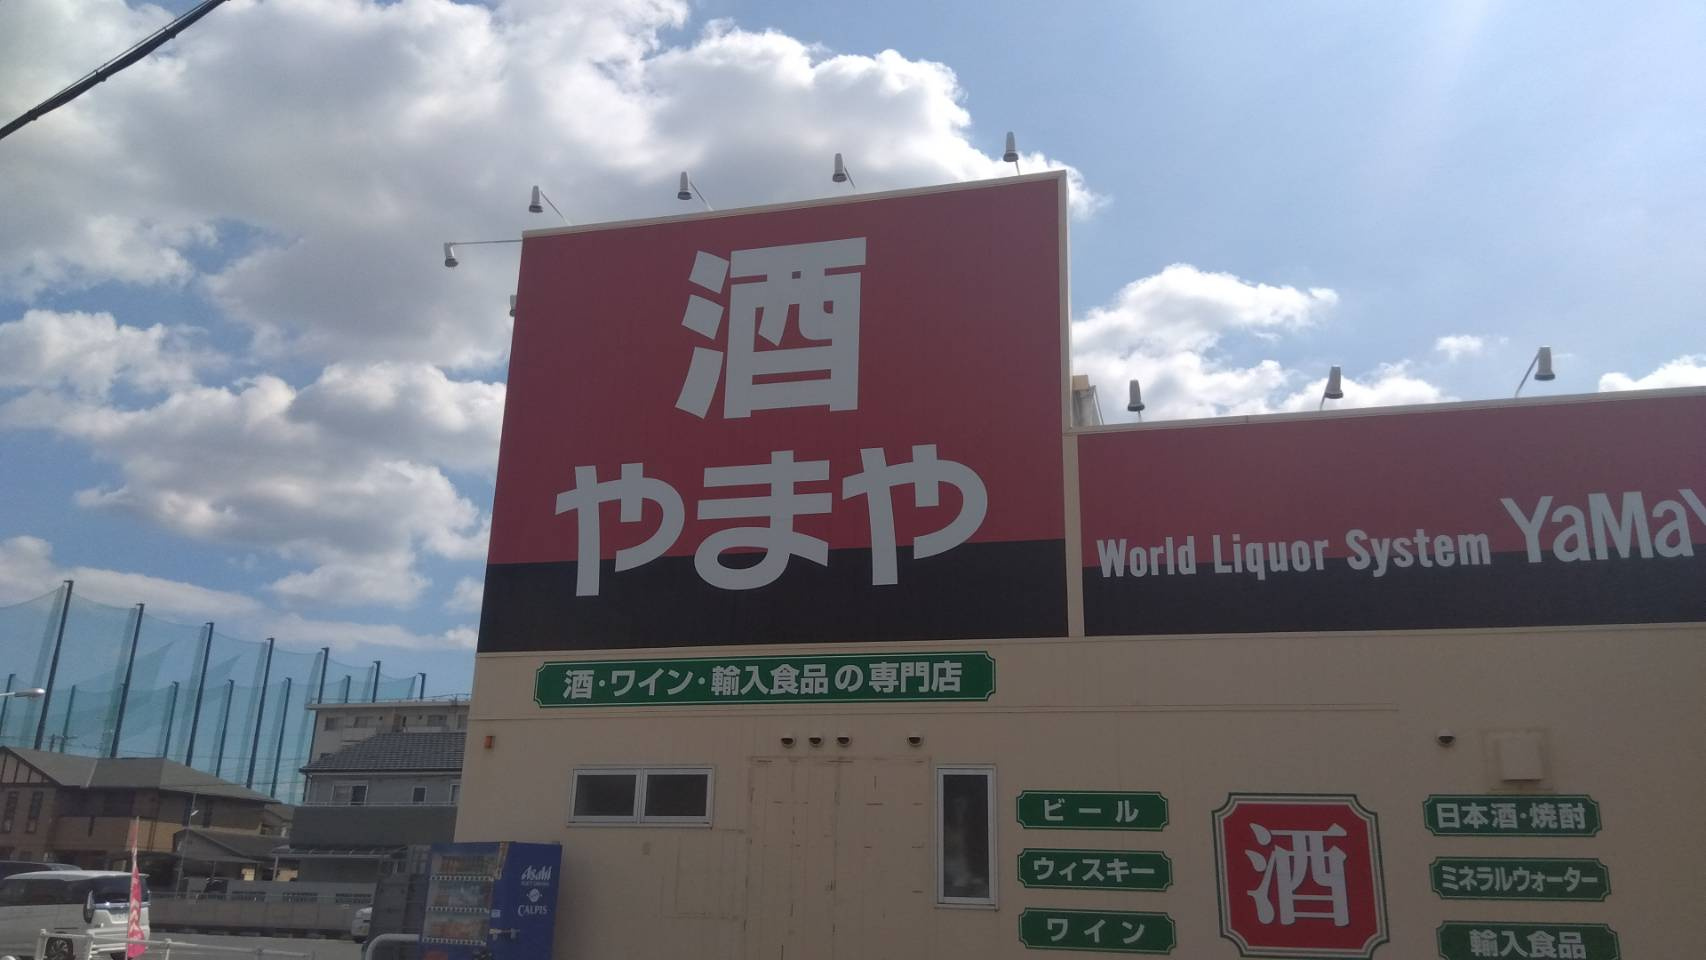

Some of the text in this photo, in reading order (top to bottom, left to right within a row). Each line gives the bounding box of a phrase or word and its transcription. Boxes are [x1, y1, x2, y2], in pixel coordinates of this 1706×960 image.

[675, 237, 867, 419] 酒
[555, 444, 988, 596] やまや
[1097, 536, 1197, 578] World
[1212, 534, 1329, 581] Liquor
[1345, 529, 1492, 578] System
[563, 661, 962, 699] 酒・ワイン・輸入食品の専門店
[1043, 798, 1139, 823] ビール
[1436, 802, 1586, 830] 日本酒・焼酎
[521, 865, 552, 881] Asahi
[1033, 857, 1155, 882] ウィスキー
[1244, 823, 1349, 926] 酒
[1442, 866, 1598, 892] ミネラルウォーター
[518, 905, 548, 917] CALPIS
[1047, 918, 1145, 944] ワイン
[1469, 929, 1587, 960] 輸入食品
